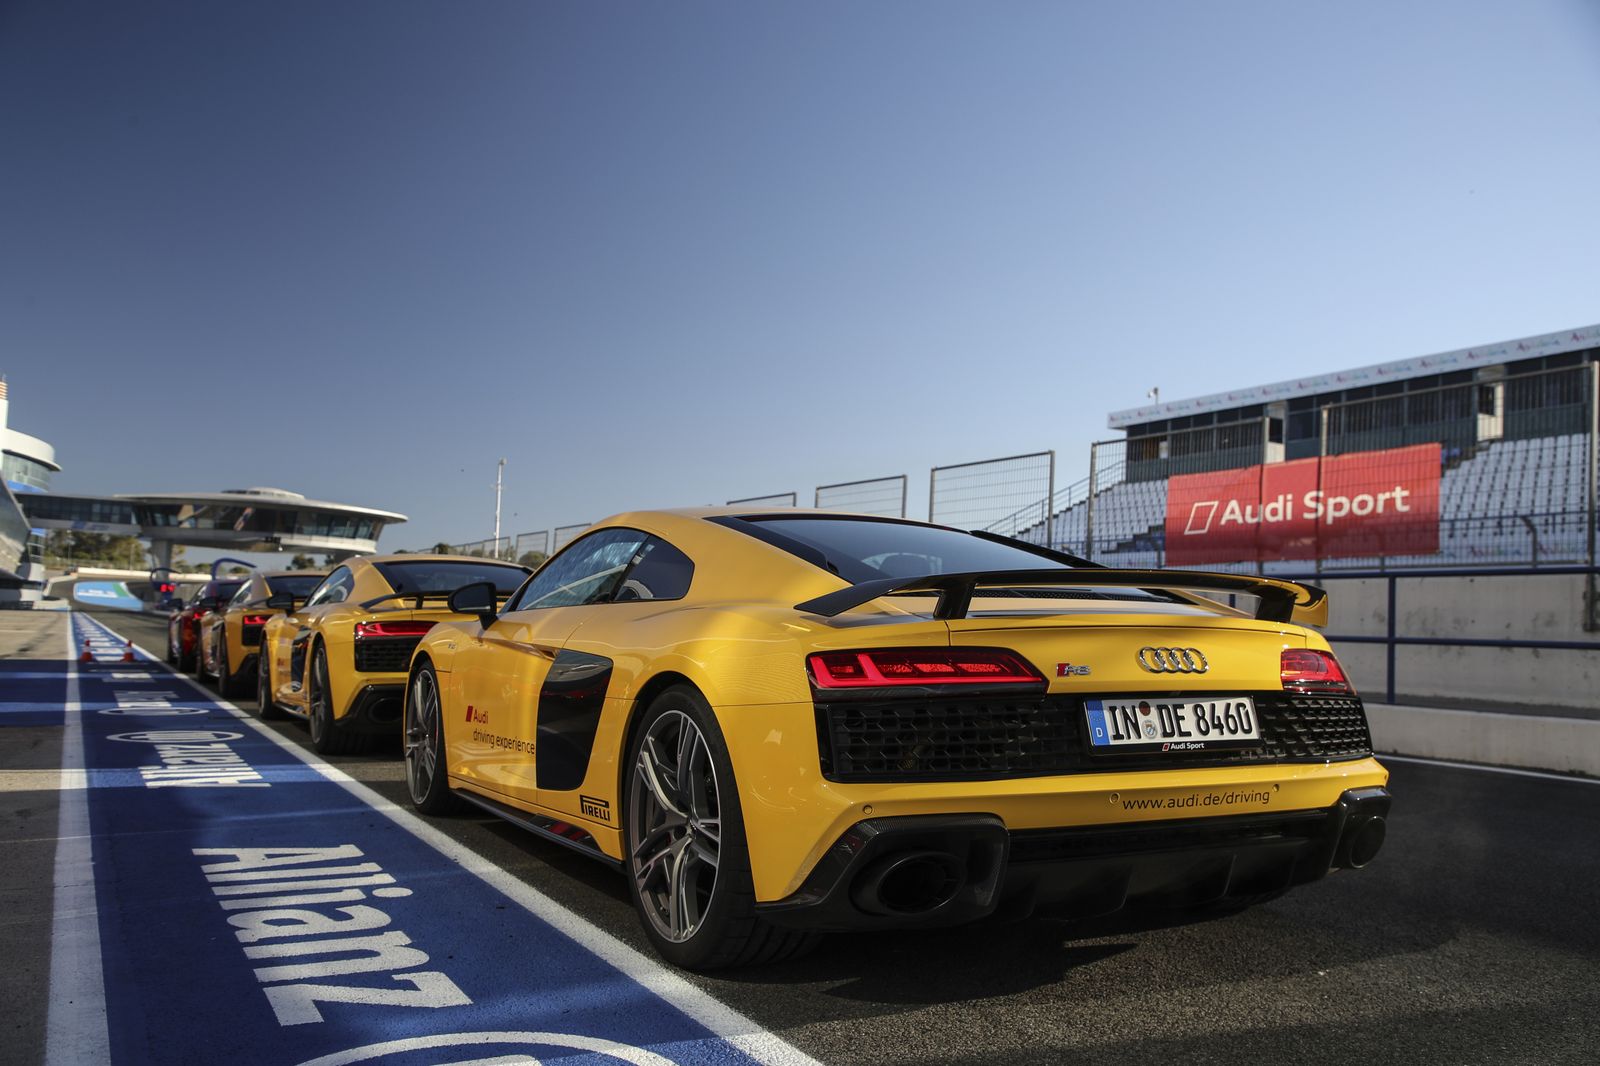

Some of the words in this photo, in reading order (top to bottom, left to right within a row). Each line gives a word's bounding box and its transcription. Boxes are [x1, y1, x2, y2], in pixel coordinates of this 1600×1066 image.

[1220, 494, 1294, 526] Audi
[1303, 486, 1411, 525] Sport
[473, 709, 489, 724] Audi
[1109, 705, 1142, 740] IN
[1157, 704, 1192, 738] DE
[1193, 702, 1253, 736] 8460
[473, 728, 495, 748] driving
[495, 736, 536, 754] experience
[1096, 727, 1104, 738] D
[1187, 742, 1205, 751] Sport
[579, 794, 611, 822] PIRELLI
[1122, 790, 1270, 810] www.audi.de/driving
[191, 843, 473, 1027] Allianz
